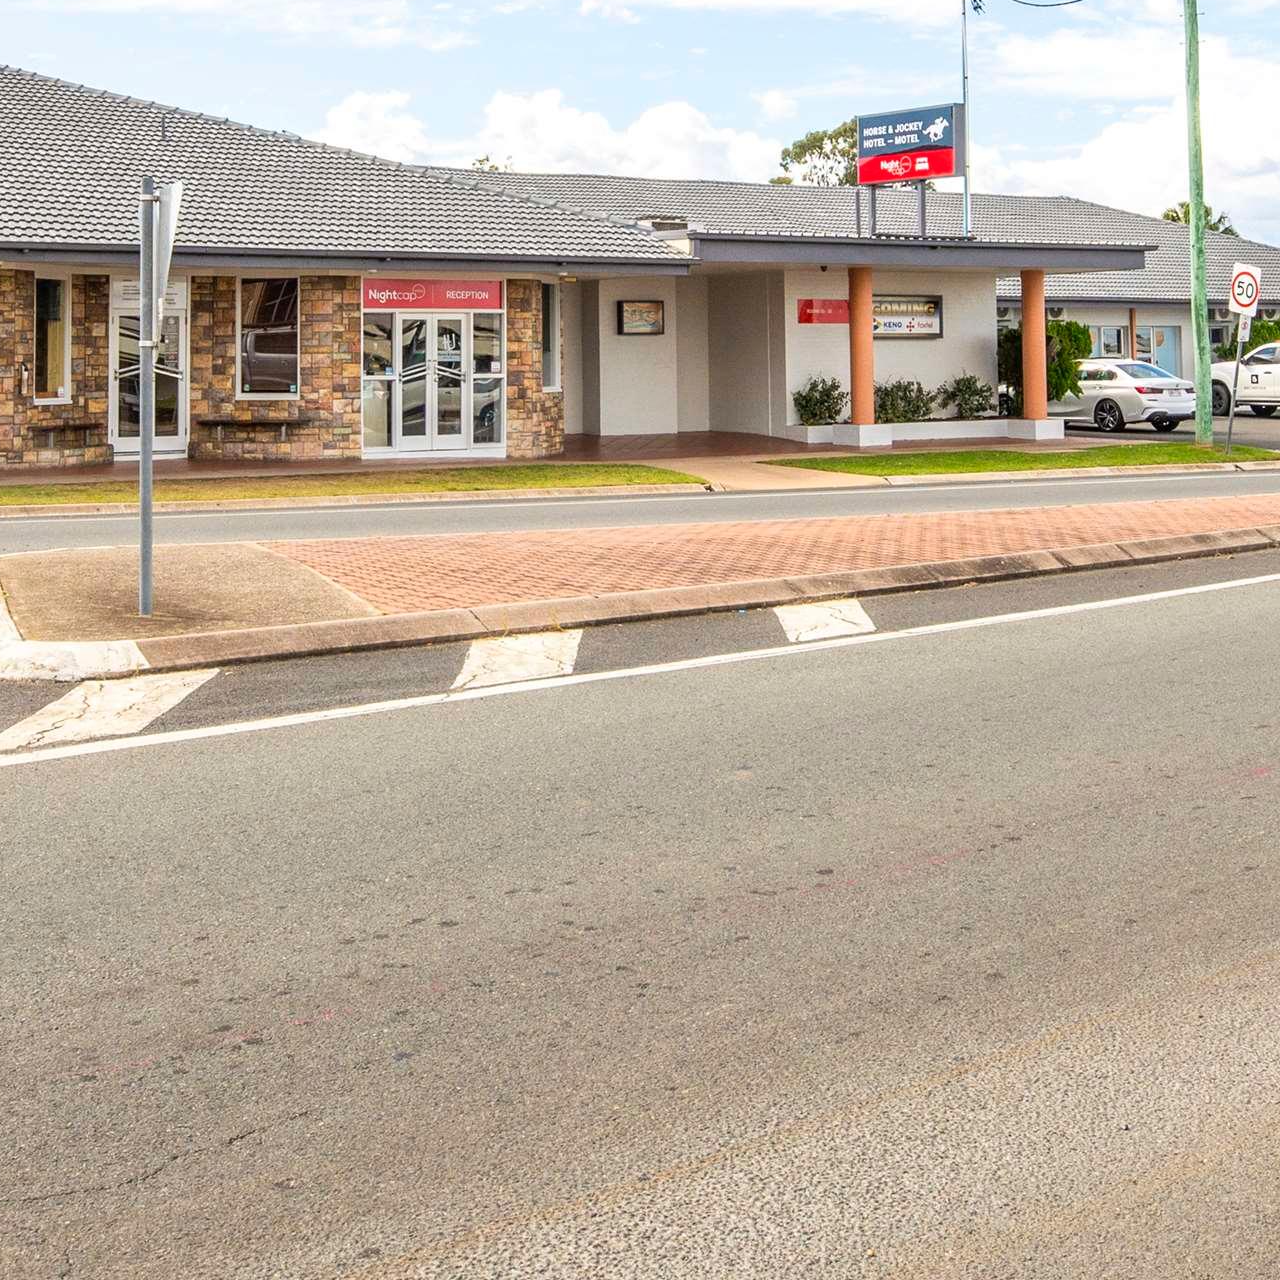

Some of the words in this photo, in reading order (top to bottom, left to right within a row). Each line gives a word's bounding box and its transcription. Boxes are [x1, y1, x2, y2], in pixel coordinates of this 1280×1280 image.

[863, 125, 887, 137] HORSE
[888, 125, 894, 134] &
[894, 121, 923, 133] JOCKEY
[863, 138, 887, 149] HOTEL
[894, 133, 920, 145] MOTEL
[368, 288, 417, 303] Nightcap
[446, 290, 489, 300] RECEPTION
[1237, 281, 1254, 298] 50
[883, 321, 903, 329] KENO
